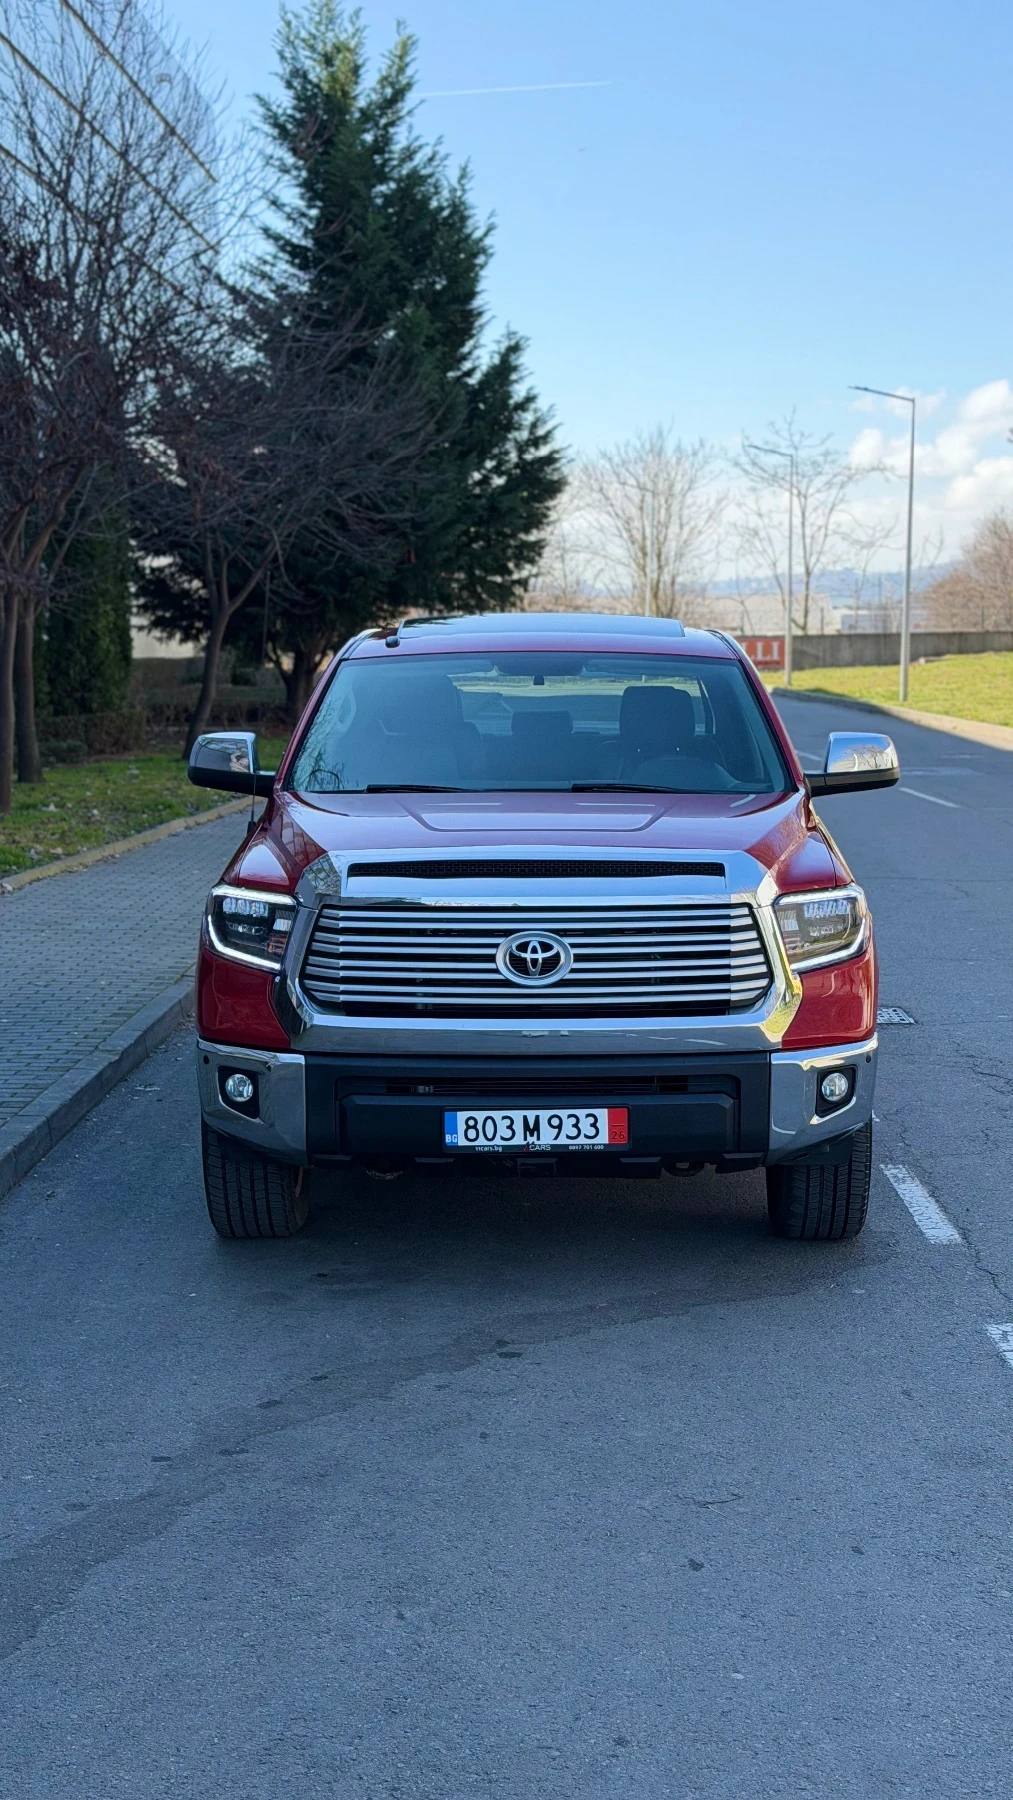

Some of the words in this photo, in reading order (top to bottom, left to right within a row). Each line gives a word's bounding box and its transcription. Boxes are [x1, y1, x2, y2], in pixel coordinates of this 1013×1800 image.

[445, 1134, 458, 1143] BG
[463, 1115, 516, 1142] 803
[522, 1114, 541, 1142] M
[547, 1113, 600, 1141] 933
[612, 1130, 625, 1140] 26
